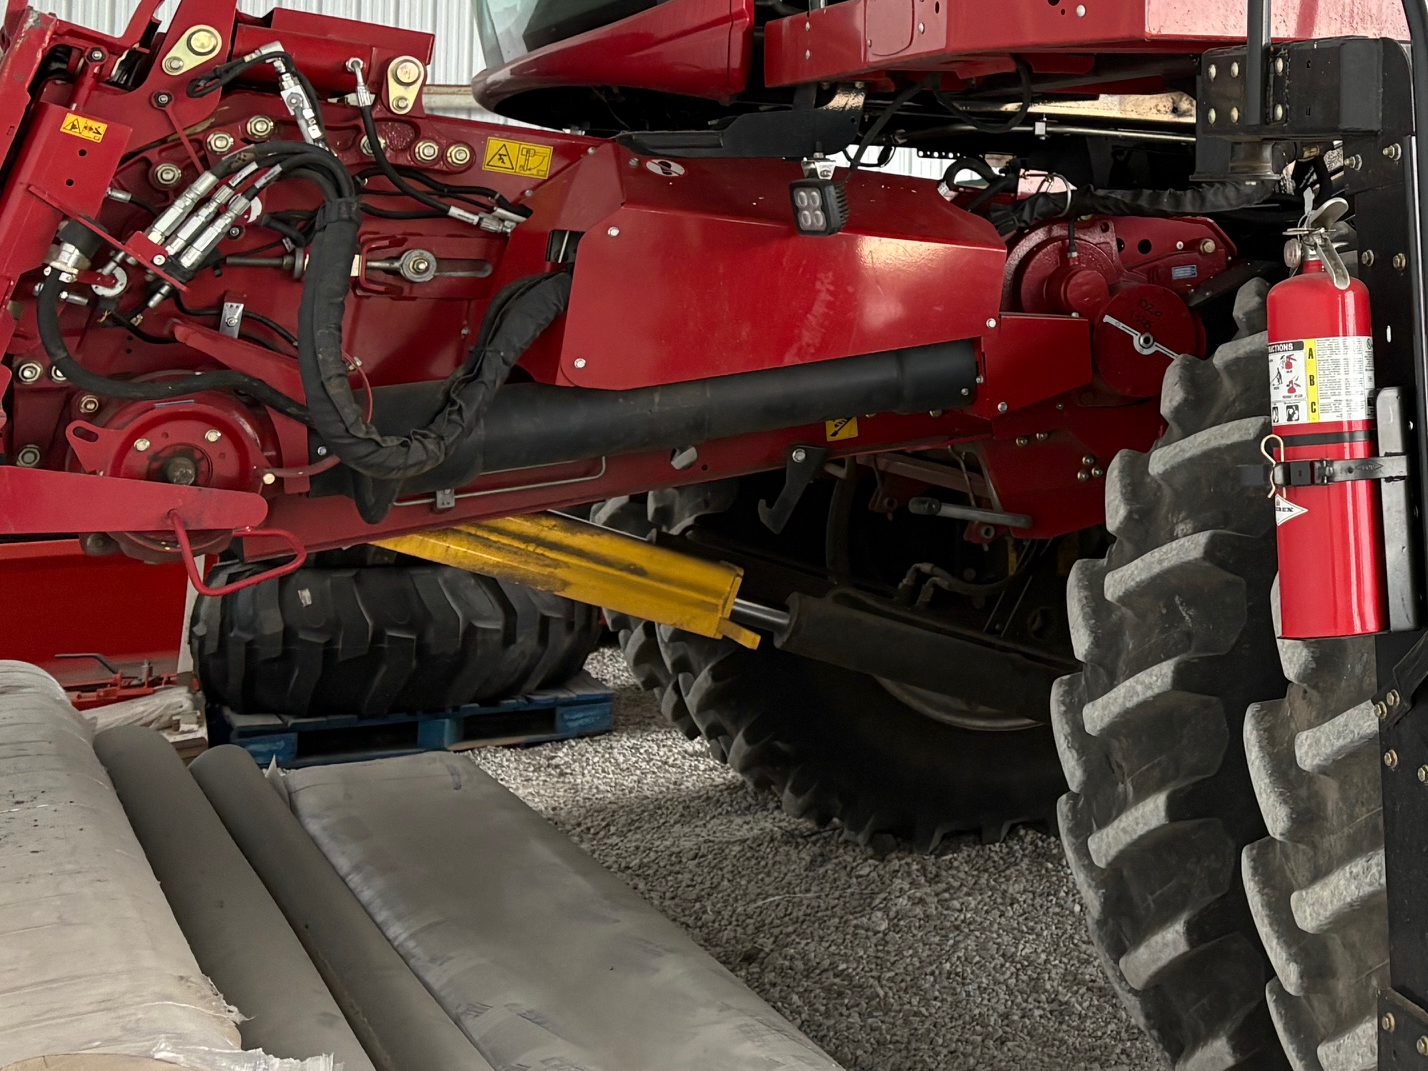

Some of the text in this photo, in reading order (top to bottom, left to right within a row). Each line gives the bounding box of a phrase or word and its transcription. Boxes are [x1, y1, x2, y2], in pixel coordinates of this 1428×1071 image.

[1308, 348, 1314, 359] A
[1309, 375, 1315, 386] B
[1310, 402, 1317, 413] C
